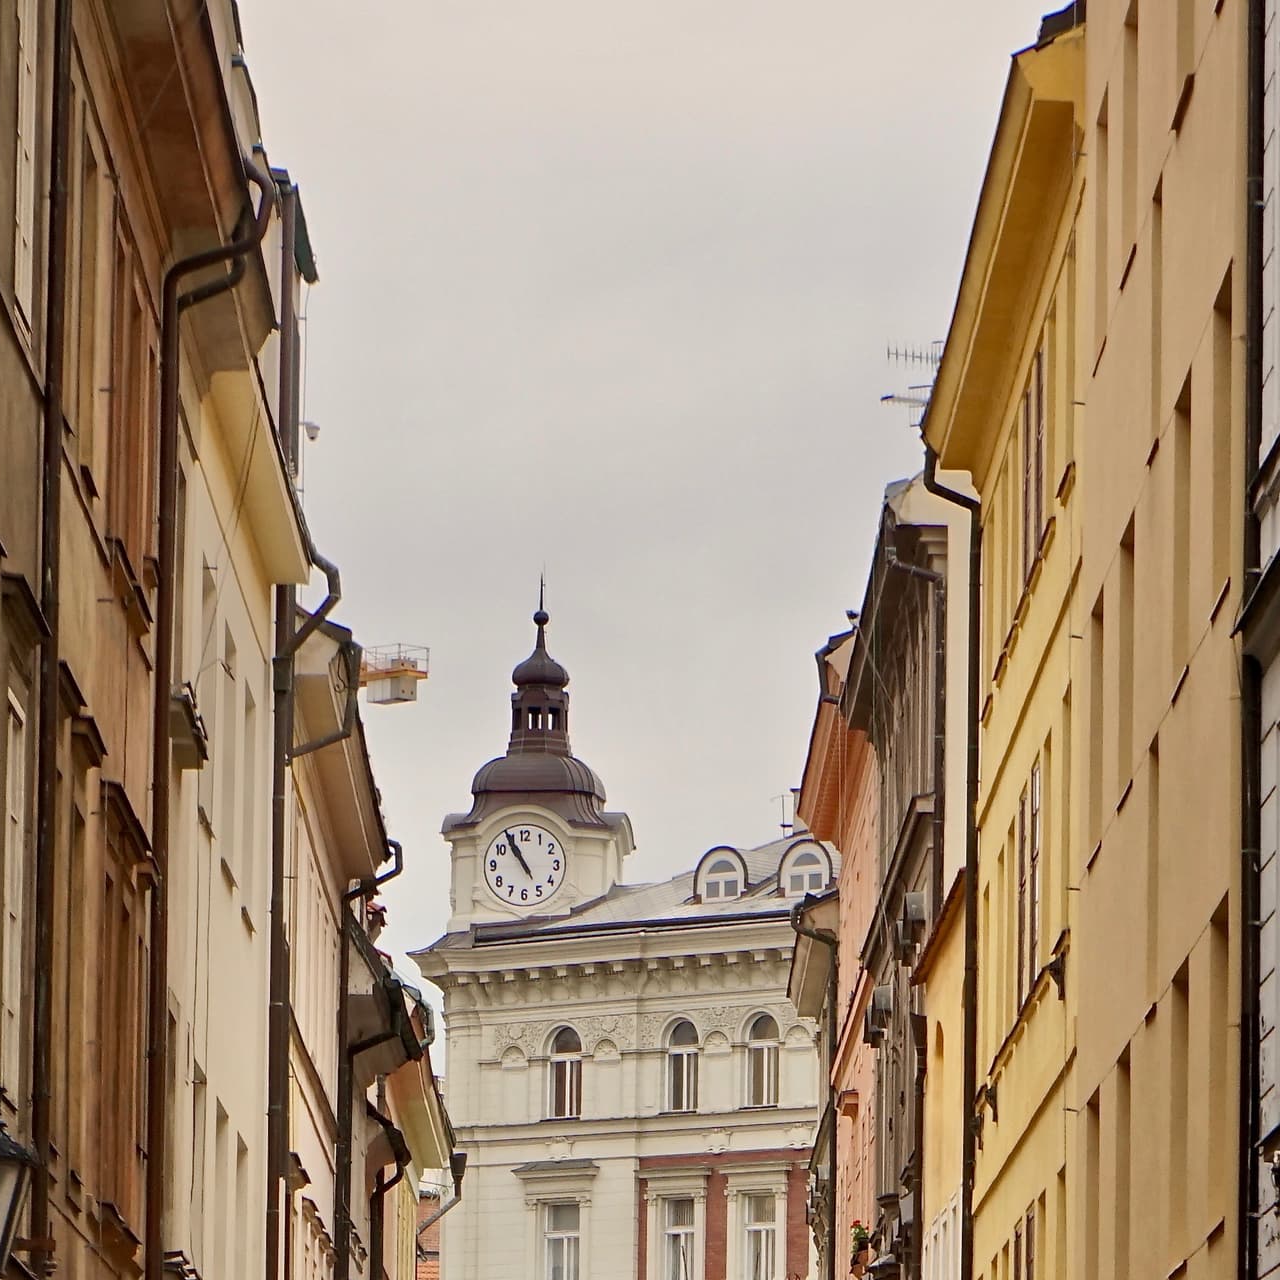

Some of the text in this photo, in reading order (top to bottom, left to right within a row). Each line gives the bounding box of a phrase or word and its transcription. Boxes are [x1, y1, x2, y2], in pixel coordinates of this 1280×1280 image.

[520, 830, 530, 842] 12
[538, 833, 542, 845] 1
[496, 844, 506, 856] 10
[548, 843, 555, 854] 2
[490, 860, 496, 871] 9
[553, 860, 560, 871] 3
[496, 876, 502, 887] 8
[547, 875, 554, 886] 4
[508, 886, 514, 897] 7
[521, 889, 528, 900] 6
[536, 886, 542, 897] 5
